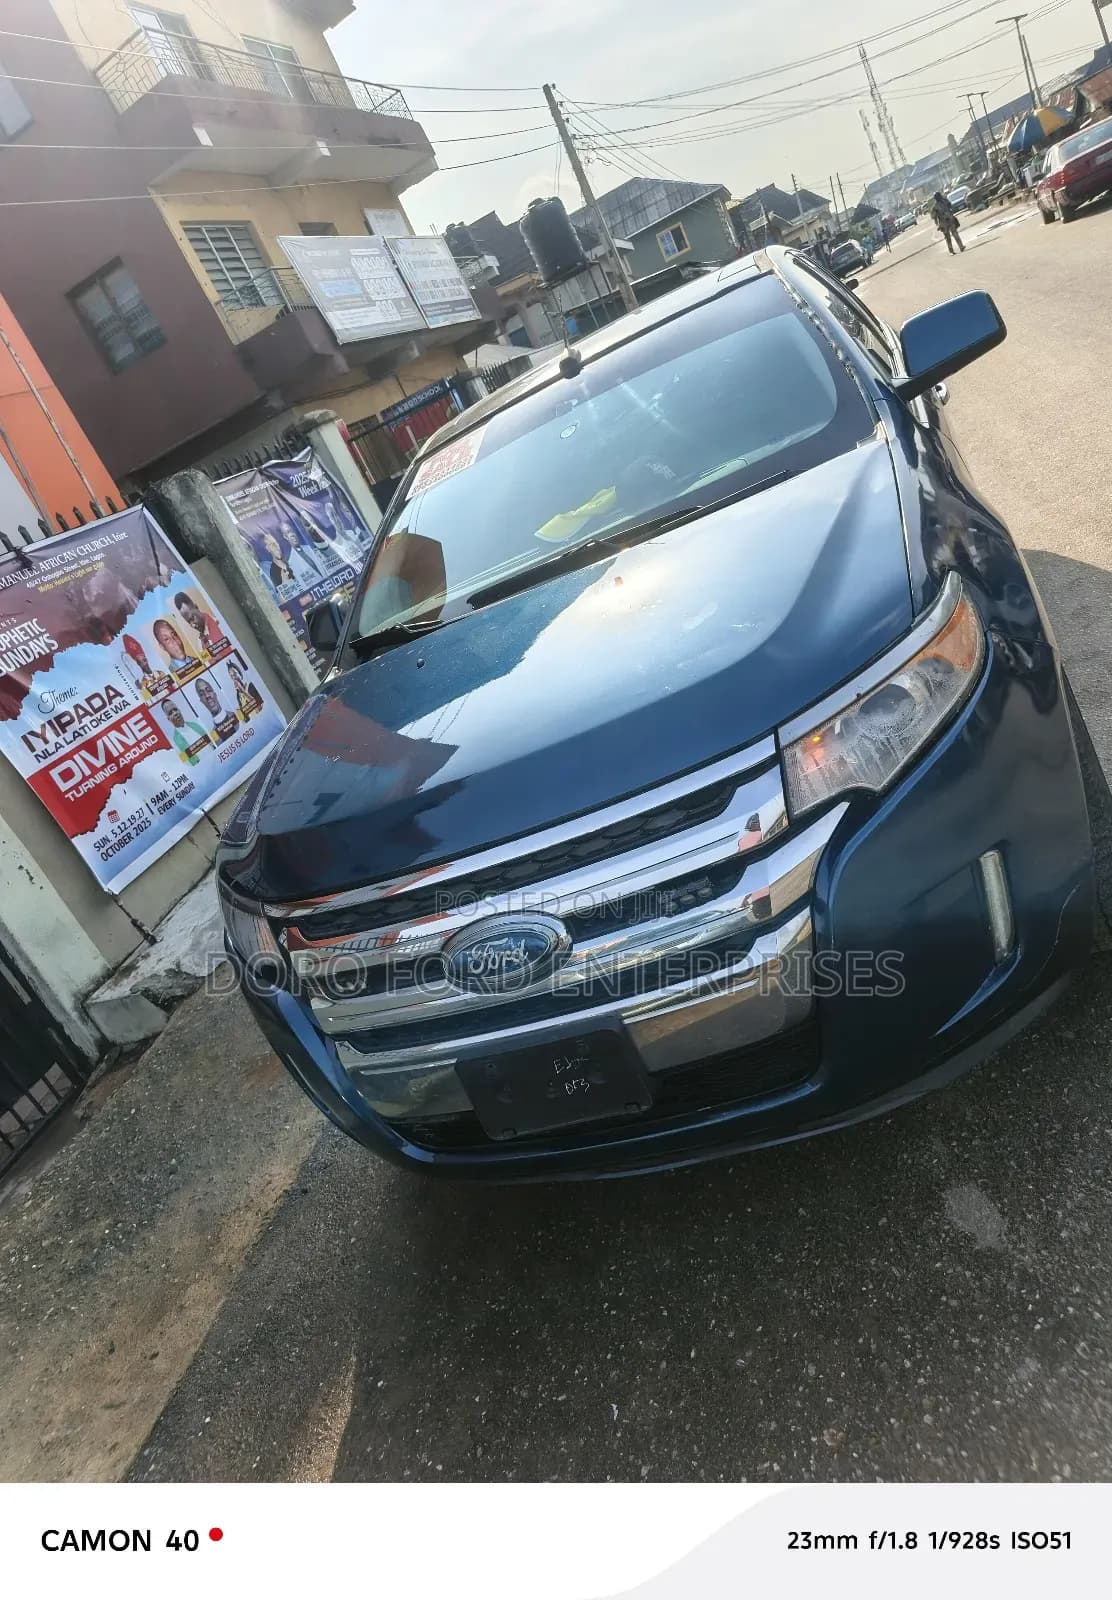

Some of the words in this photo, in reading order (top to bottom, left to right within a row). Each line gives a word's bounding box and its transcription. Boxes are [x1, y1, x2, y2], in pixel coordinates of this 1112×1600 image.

[39, 550, 78, 572] AFRICAN
[76, 535, 115, 556] CHURCH,
[0, 617, 17, 629] NTS
[20, 684, 125, 753] IYIPADA
[37, 686, 79, 714] Theme:
[34, 744, 65, 763] NLA
[62, 723, 92, 746] LATI
[92, 711, 113, 730] OKE
[111, 699, 131, 715] WA
[217, 743, 236, 764] JESUS
[233, 738, 242, 751] IS
[240, 727, 255, 745] LORD
[49, 712, 153, 793] DIVINE
[64, 763, 118, 802] TURNING
[118, 734, 159, 768] AROUND
[150, 789, 168, 807] 9AM
[172, 773, 189, 791] 12PM
[157, 797, 177, 815] EVERY
[175, 781, 196, 801] SUNDAY
[93, 834, 113, 852] SUN.
[100, 832, 134, 862] OCTOBER
[133, 817, 152, 836] 2025
[469, 937, 530, 975] Ford
